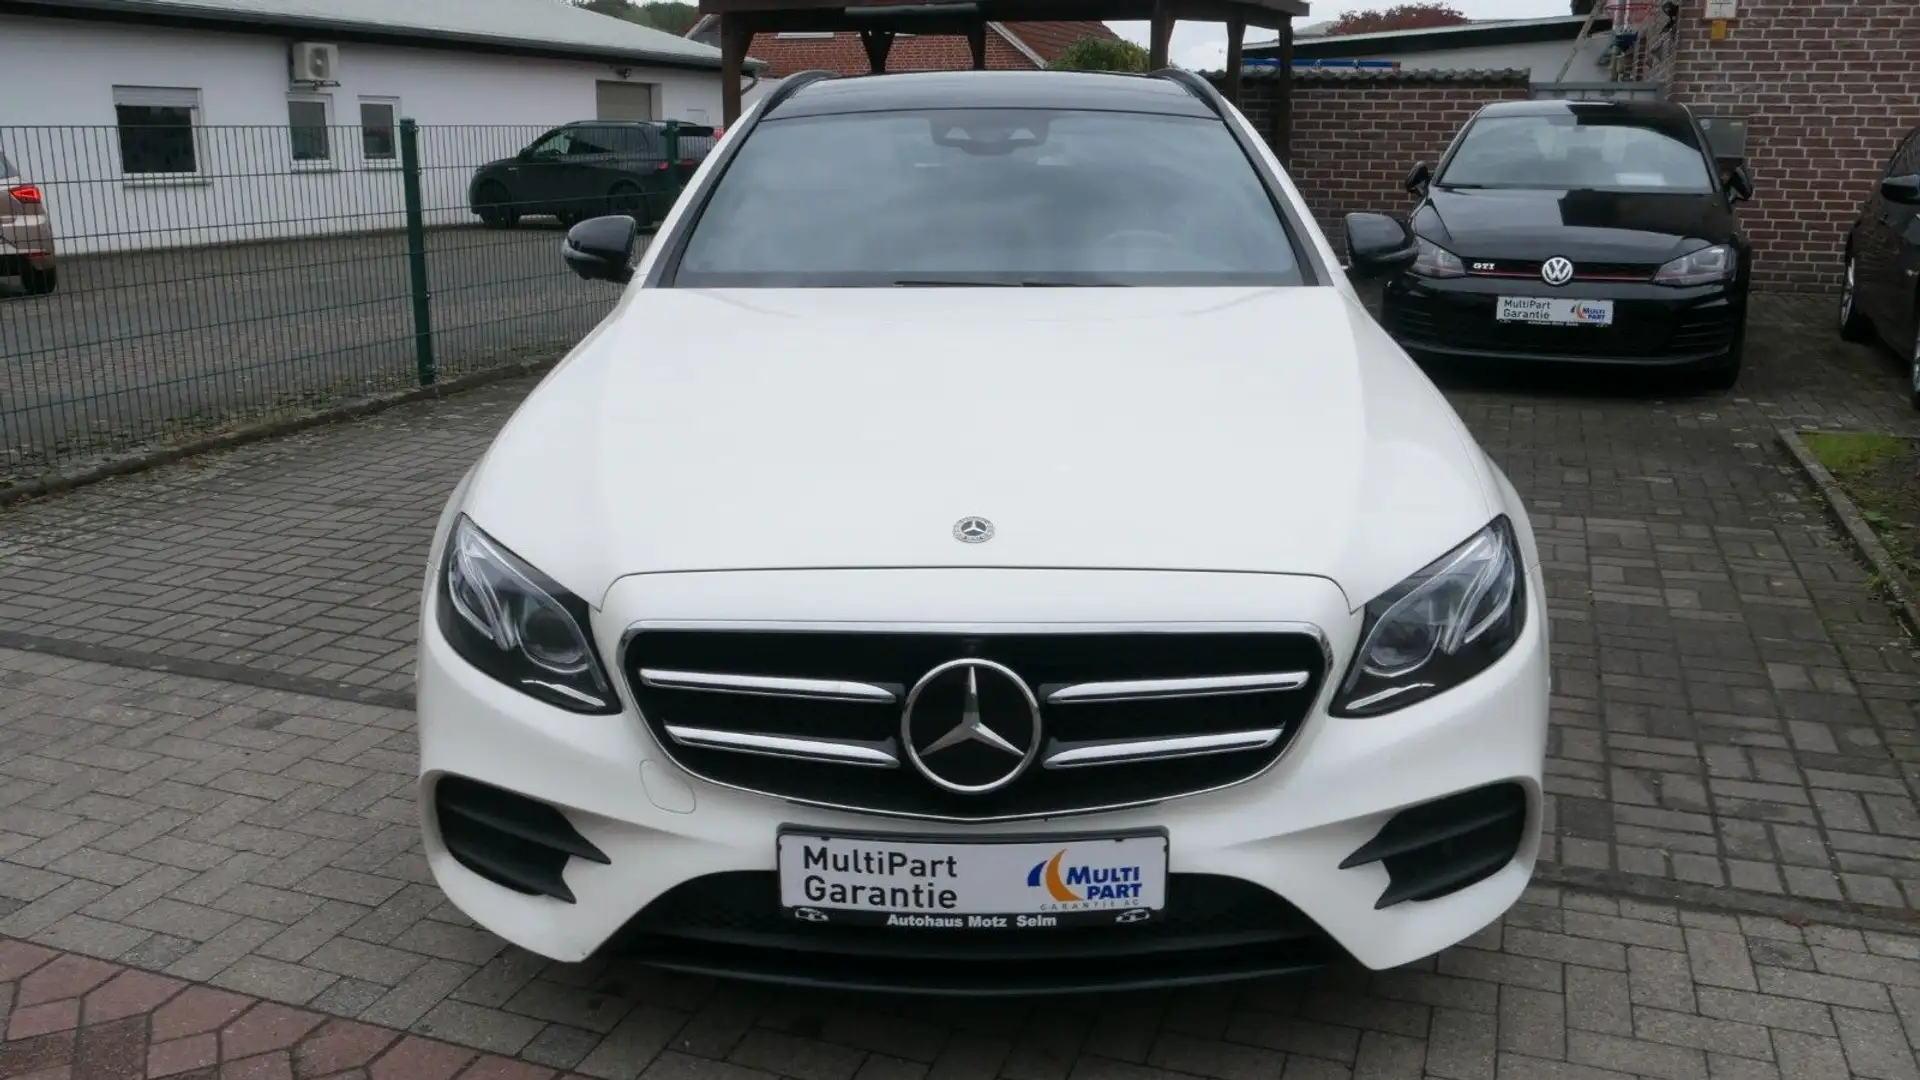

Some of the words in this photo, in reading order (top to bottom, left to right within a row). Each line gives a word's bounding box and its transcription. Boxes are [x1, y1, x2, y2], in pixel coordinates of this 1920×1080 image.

[1473, 262, 1495, 270] GTI
[1541, 256, 1573, 285] VW
[1503, 299, 1550, 309] MultiPart
[1503, 309, 1550, 319] Garantie
[803, 845, 957, 878] MultiPart
[1066, 866, 1140, 885] MULTI
[804, 875, 957, 909] Garantie
[1087, 883, 1142, 900] PART
[887, 914, 963, 927] Autohaus
[968, 916, 1007, 927] Motz
